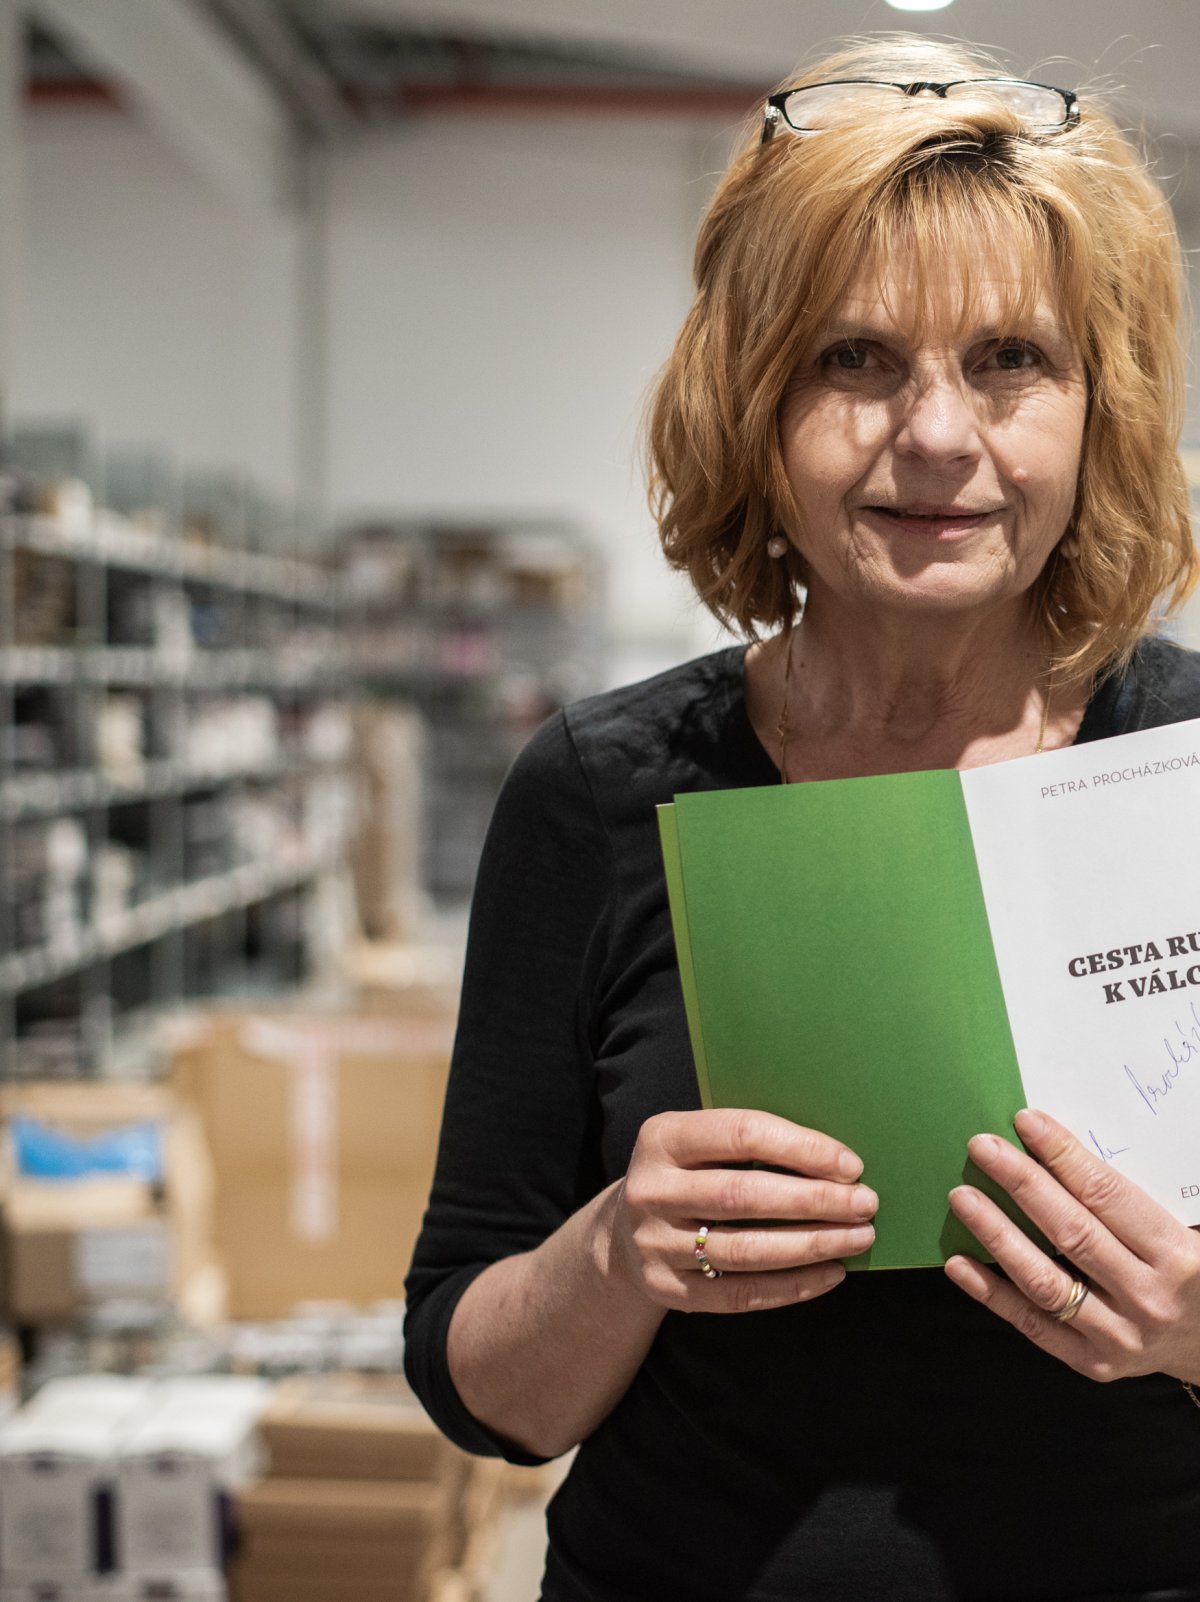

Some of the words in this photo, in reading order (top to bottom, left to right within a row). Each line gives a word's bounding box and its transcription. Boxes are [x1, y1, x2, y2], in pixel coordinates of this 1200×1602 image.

[1040, 779, 1088, 799] PETRA
[1093, 752, 1200, 788] PROCHÁZKOVÁ
[1068, 941, 1164, 978] CESTA
[1102, 982, 1126, 1005] K
